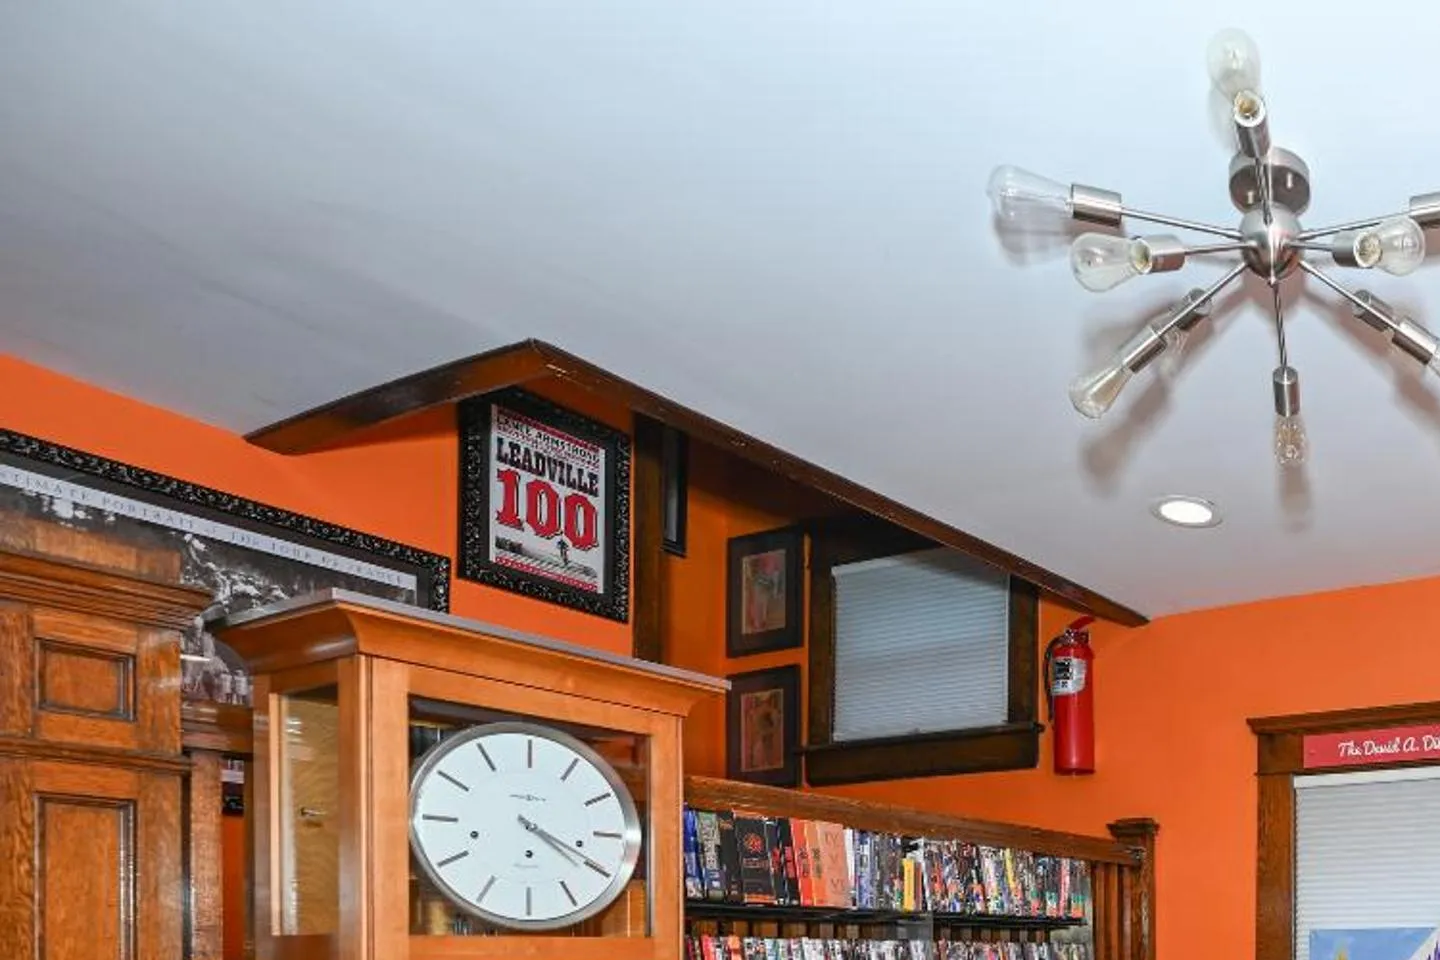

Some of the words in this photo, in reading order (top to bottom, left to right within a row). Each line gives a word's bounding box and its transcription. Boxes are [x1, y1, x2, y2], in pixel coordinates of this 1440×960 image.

[497, 436, 599, 498] LEADVILLE
[496, 468, 599, 551] 100
[1338, 740, 1362, 757] The
[1363, 737, 1400, 756] David
